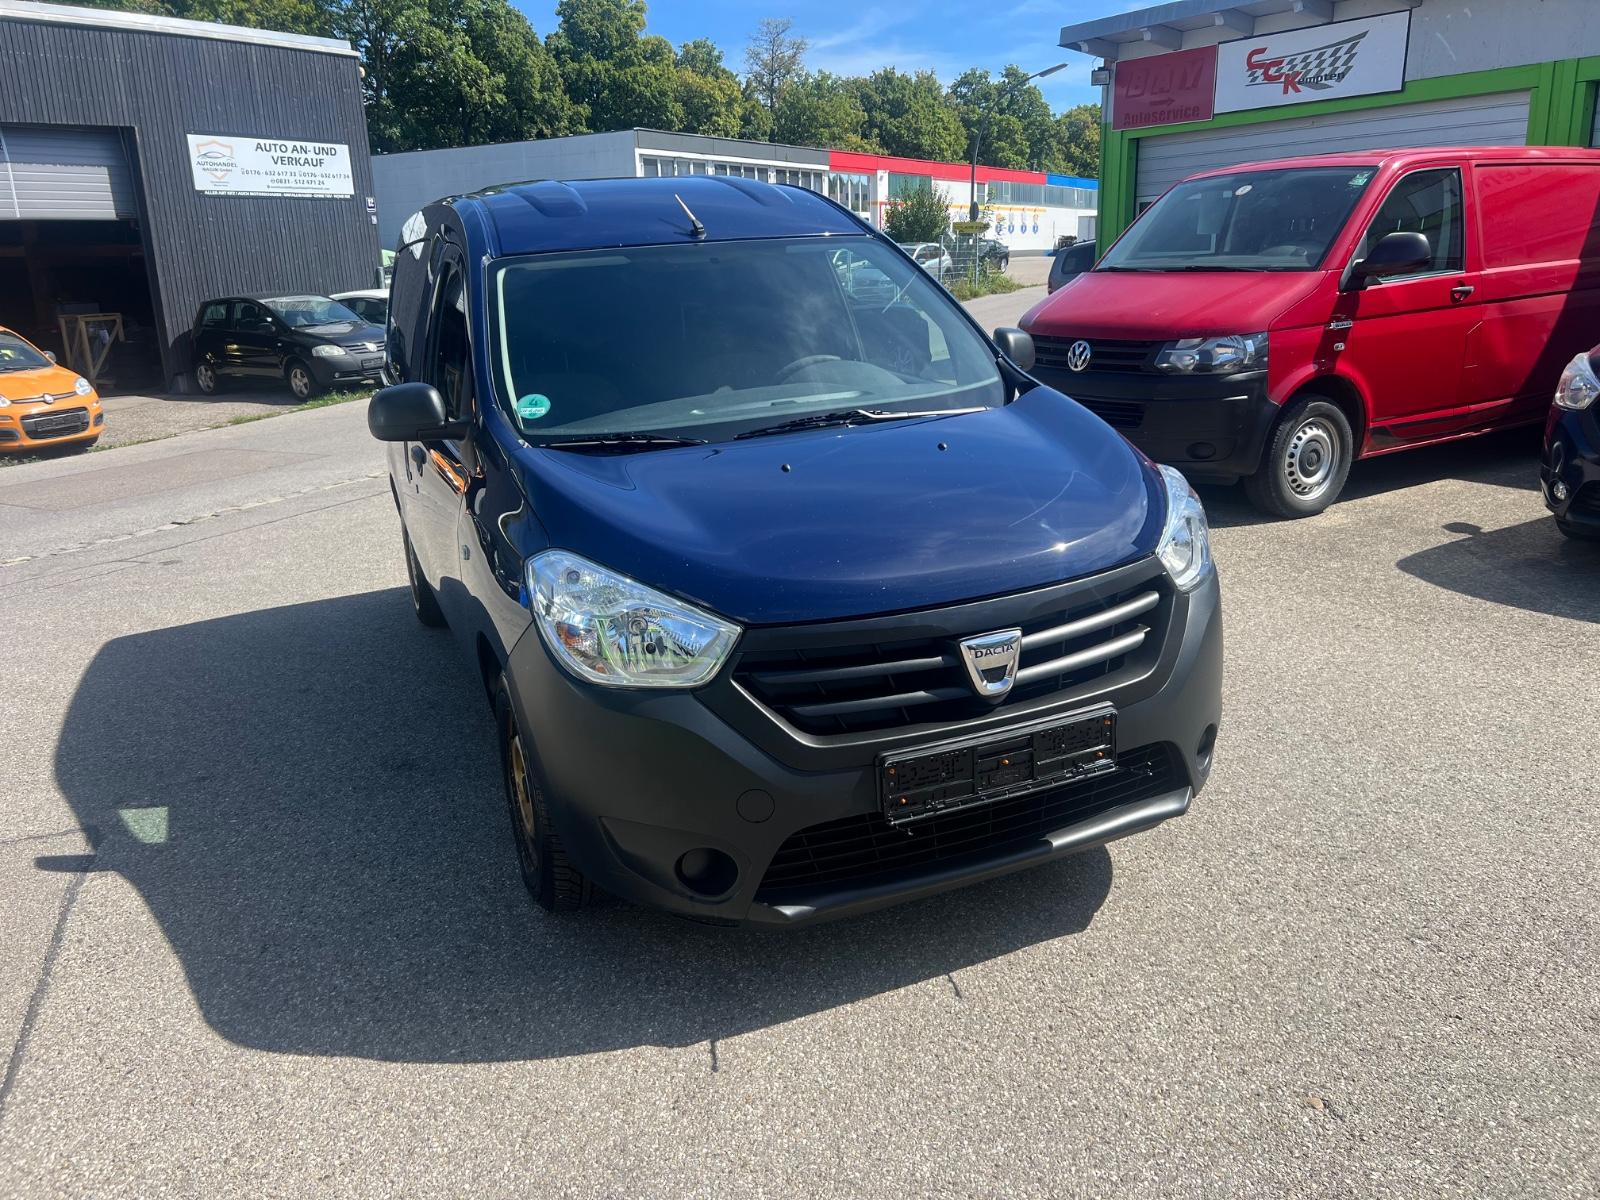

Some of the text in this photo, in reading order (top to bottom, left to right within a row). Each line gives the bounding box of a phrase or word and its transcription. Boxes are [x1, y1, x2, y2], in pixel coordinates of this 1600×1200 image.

[1123, 105, 1200, 126] Autoservice
[255, 142, 337, 156] AUTO AN- UND
[196, 160, 238, 168] AUTOHANDEL
[271, 155, 325, 167] VERKAUF
[975, 644, 1014, 659] DACIA
